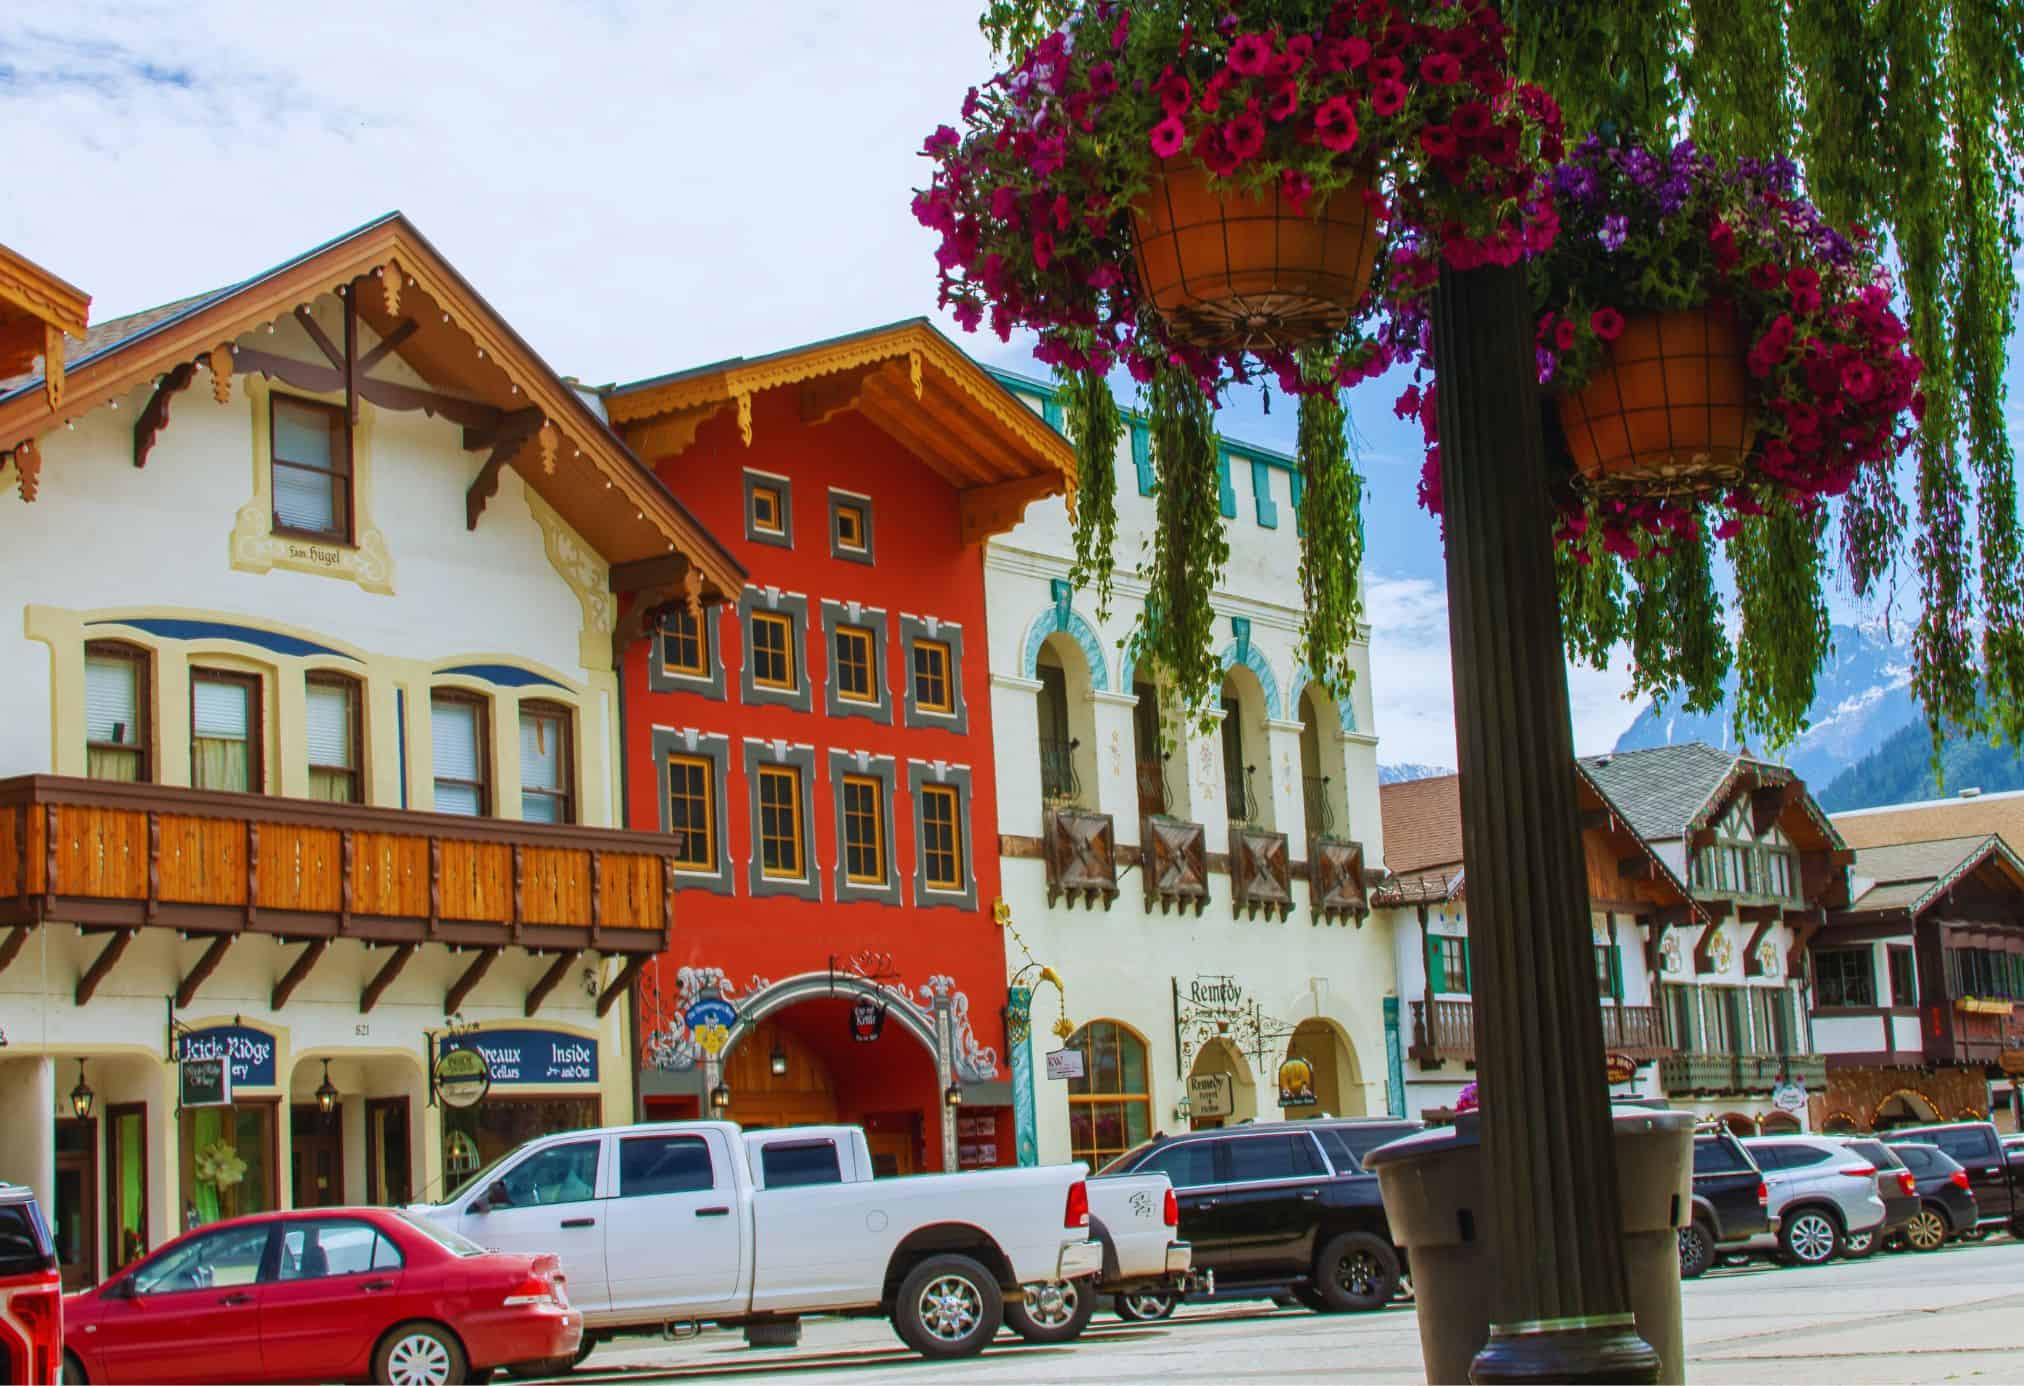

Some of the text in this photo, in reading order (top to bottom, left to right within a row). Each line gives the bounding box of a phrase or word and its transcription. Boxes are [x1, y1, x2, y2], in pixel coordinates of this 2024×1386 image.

[1191, 979, 1242, 1006] Remedy
[226, 1036, 271, 1065] Ridge
[552, 1043, 590, 1065] Inside
[490, 1065, 519, 1080] Cellars
[561, 1065, 575, 1078] and
[1191, 1078, 1224, 1091] Remedy
